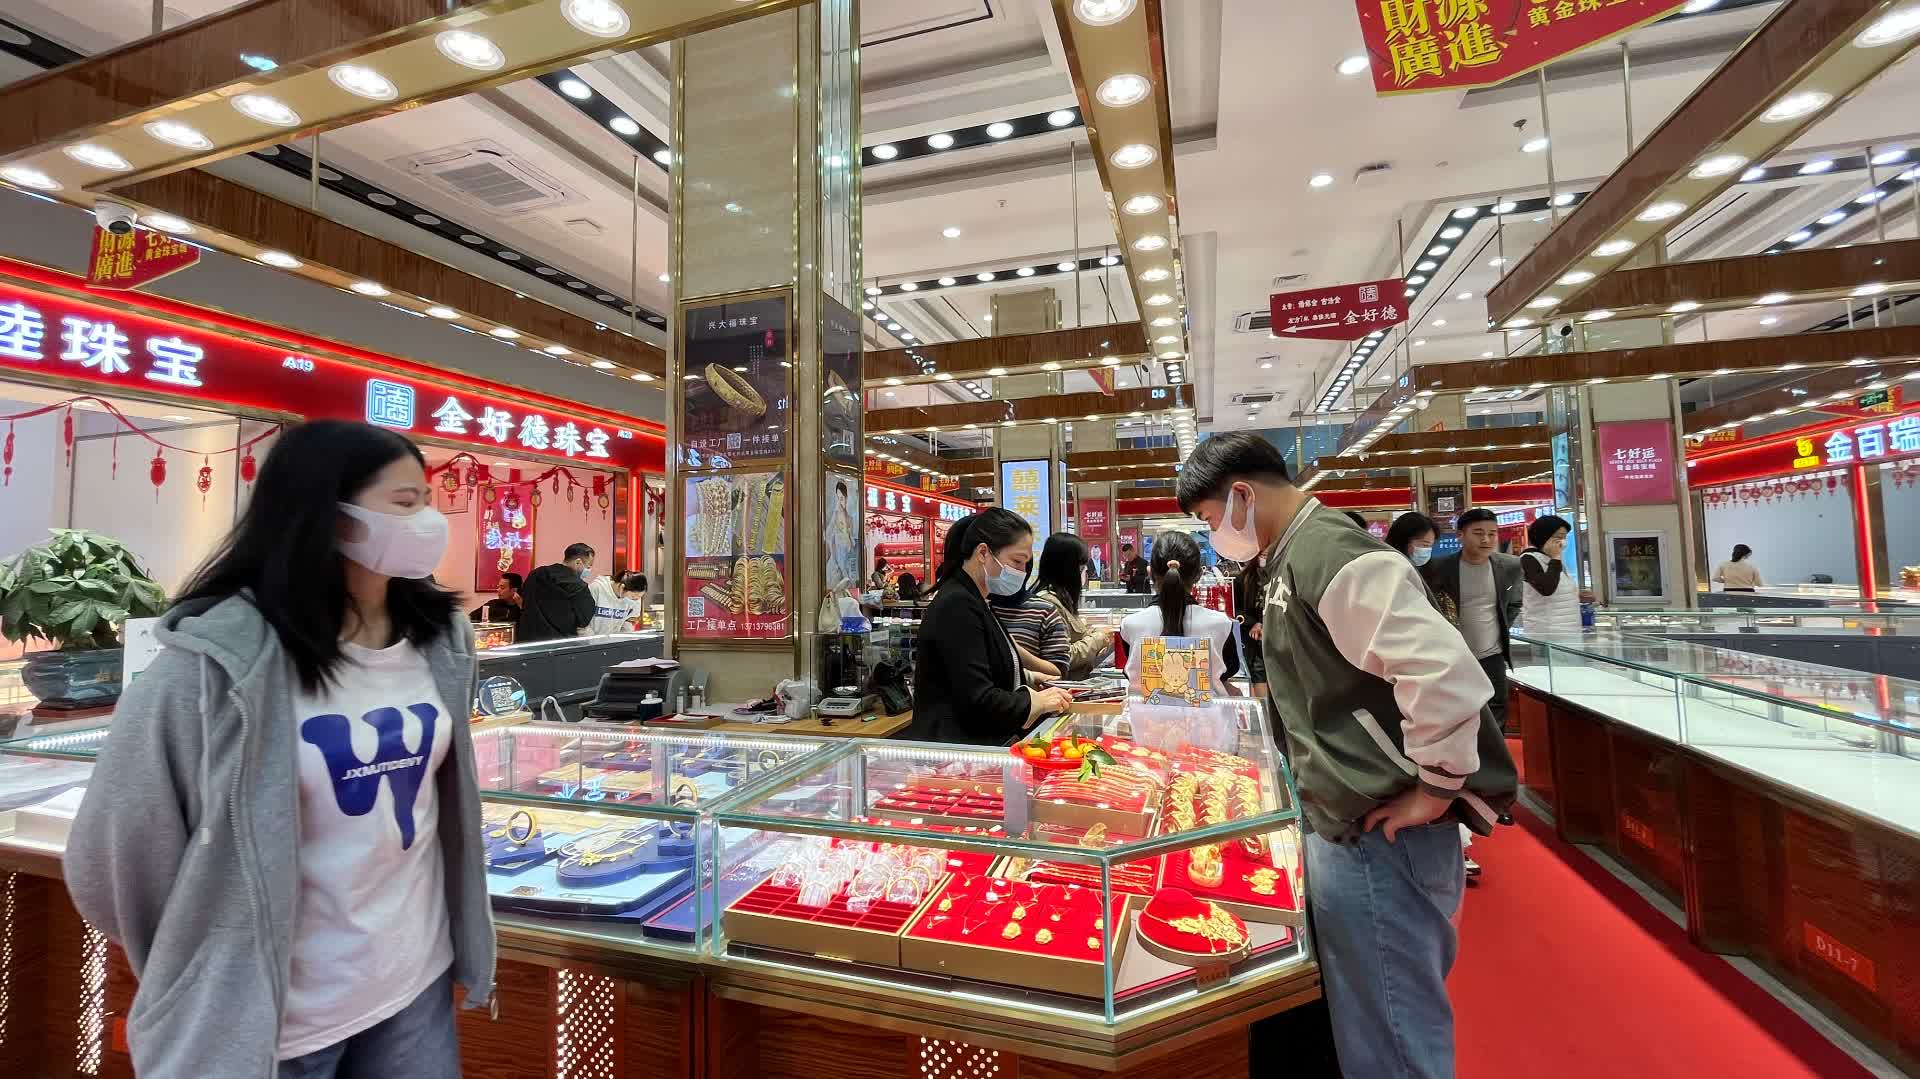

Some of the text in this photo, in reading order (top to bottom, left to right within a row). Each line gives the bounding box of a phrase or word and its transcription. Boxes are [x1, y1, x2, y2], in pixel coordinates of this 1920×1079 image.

[1528, 0, 1633, 28] 黄金珠
[1385, 22, 1507, 88] 廣進
[708, 316, 759, 331] 兴大福珠宝
[1342, 304, 1398, 326] 金好德
[282, 355, 315, 372] A19
[431, 396, 611, 459] 金好德珠宝
[743, 434, 780, 445] 一件接单
[1824, 416, 1920, 464] 金百瑞
[1612, 446, 1656, 460] 七好运
[687, 618, 737, 632] 工厂接单点
